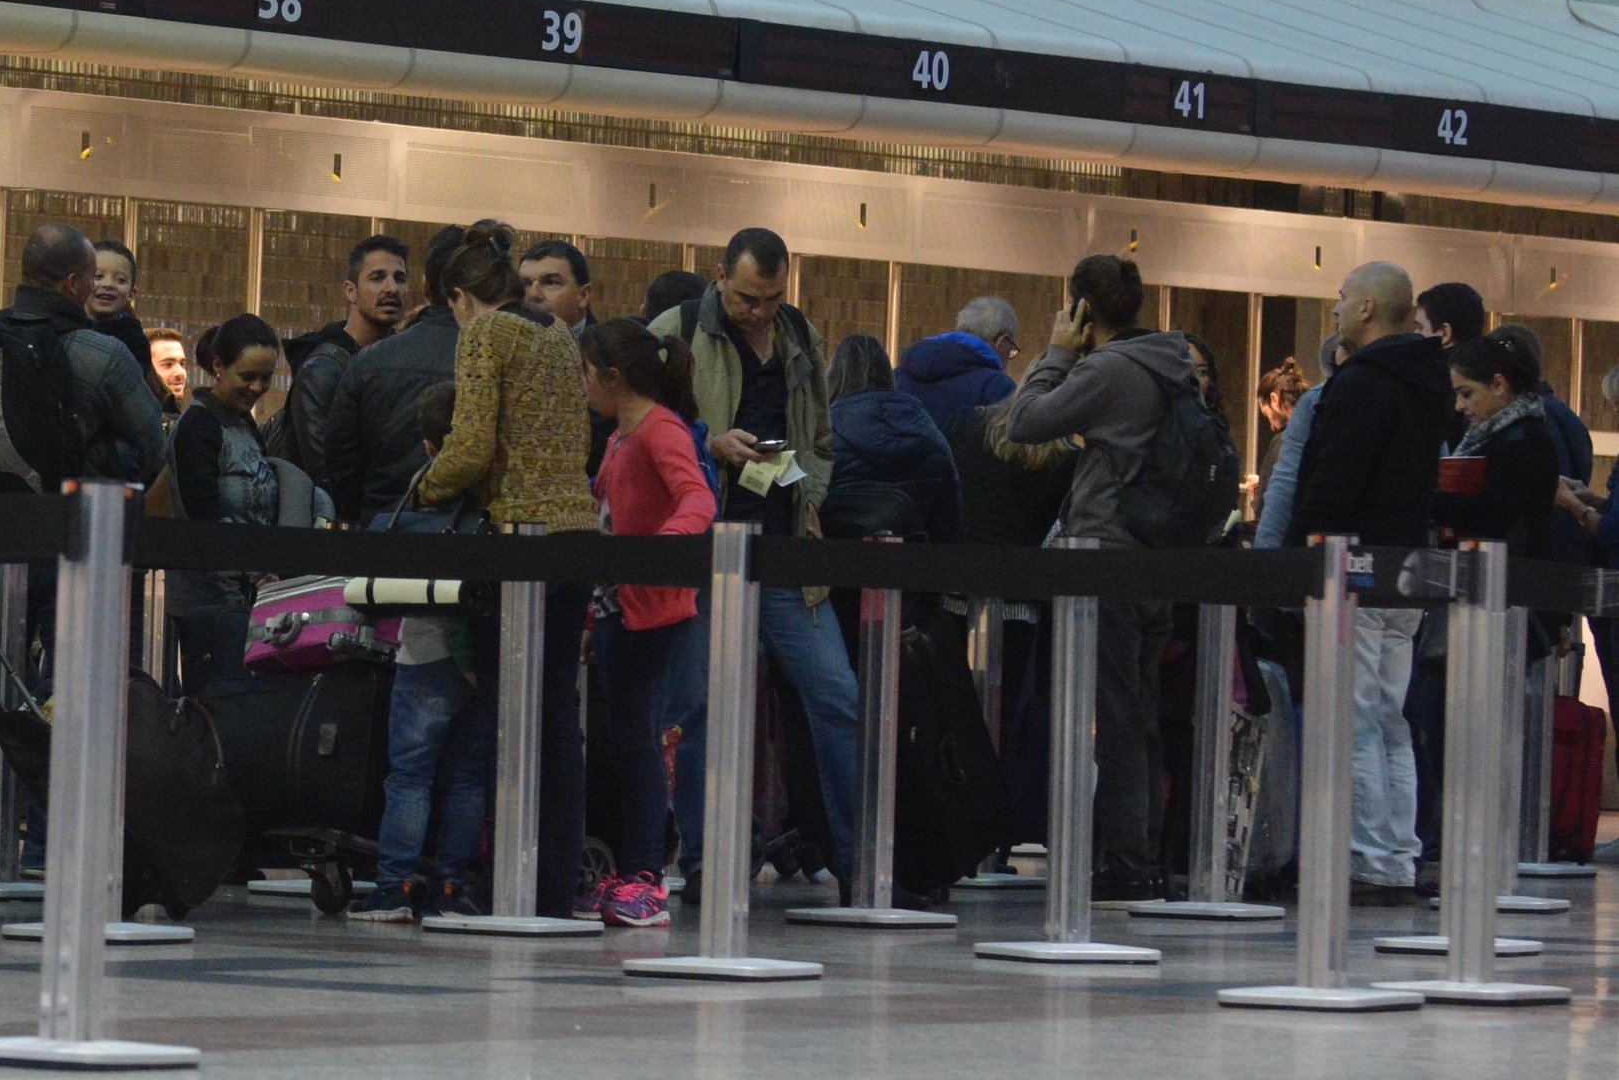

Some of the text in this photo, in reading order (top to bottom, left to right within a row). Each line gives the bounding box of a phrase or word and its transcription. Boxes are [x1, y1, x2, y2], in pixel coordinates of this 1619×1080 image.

[541, 10, 583, 54] 39
[912, 50, 950, 91] 40
[1174, 80, 1205, 119] 41
[1437, 108, 1468, 146] 42
